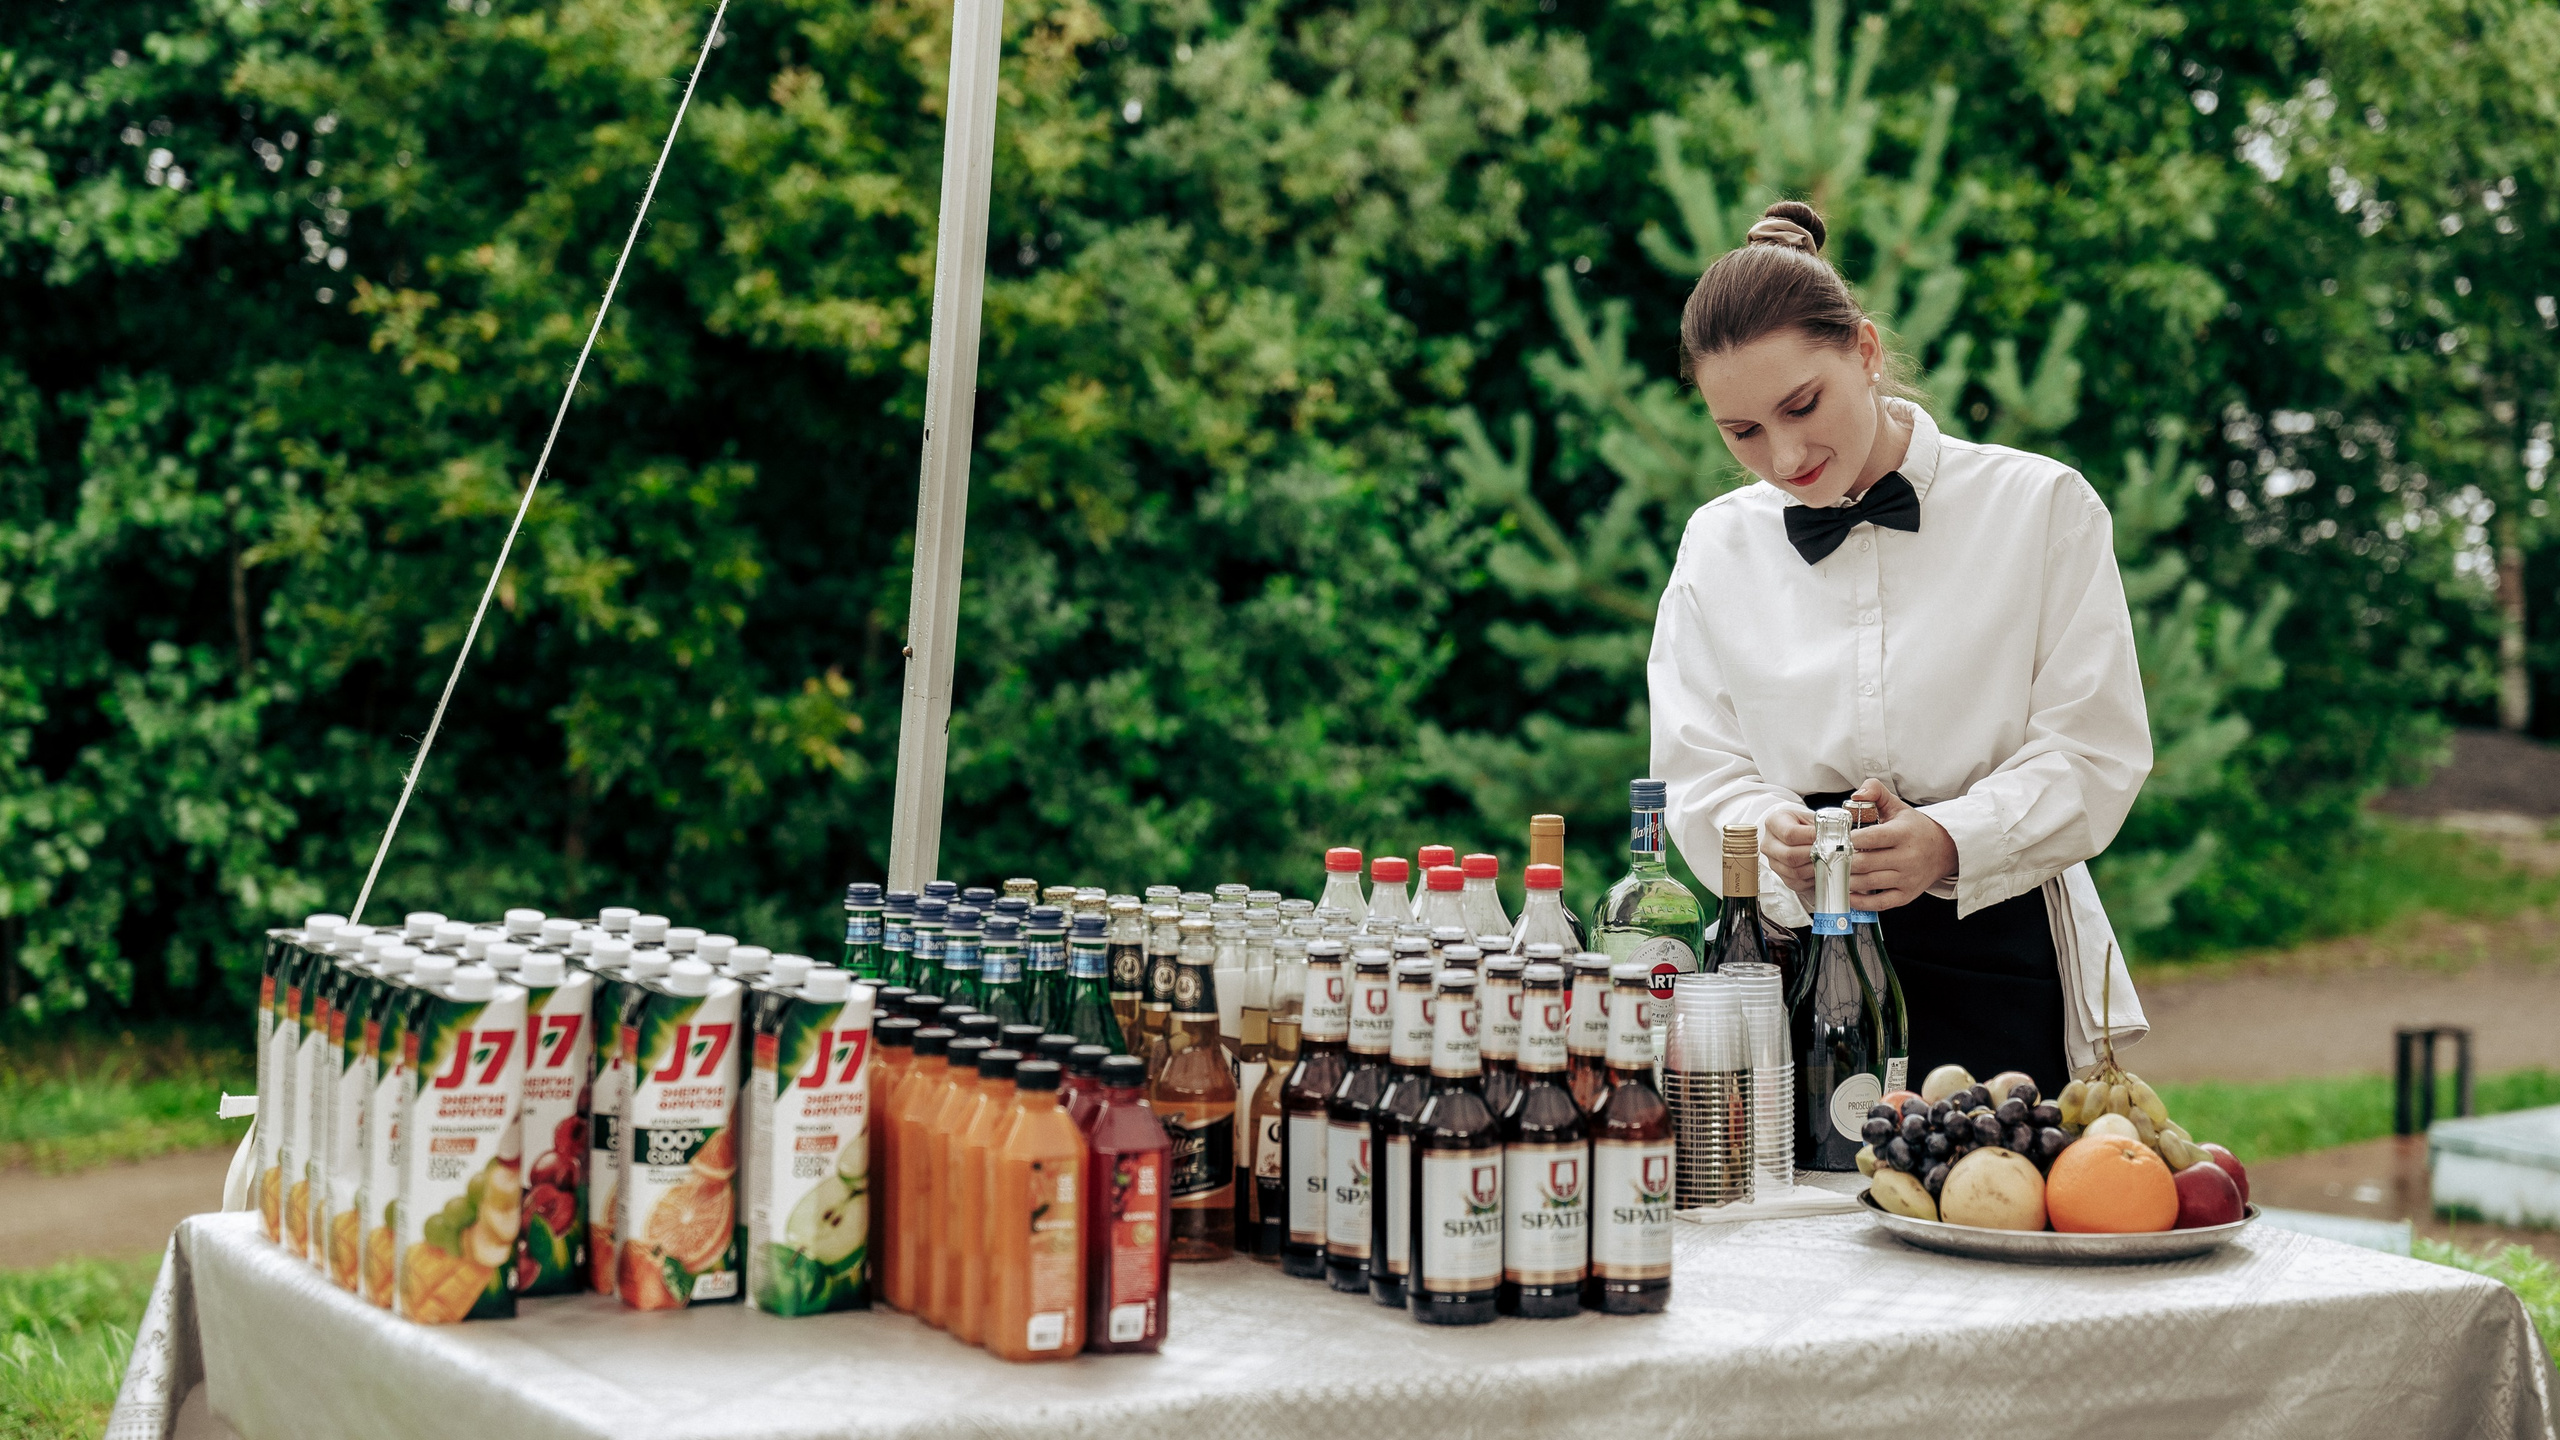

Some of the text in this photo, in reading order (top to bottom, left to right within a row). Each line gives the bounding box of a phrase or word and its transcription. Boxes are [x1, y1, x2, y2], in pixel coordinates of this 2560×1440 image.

[434, 1030, 517, 1089] J7
[654, 1023, 733, 1082] J7
[798, 1029, 869, 1088] J7
[647, 1129, 706, 1150] 100%
[1336, 1186, 1370, 1205] SPA
[1614, 1206, 1674, 1225] SPATE
